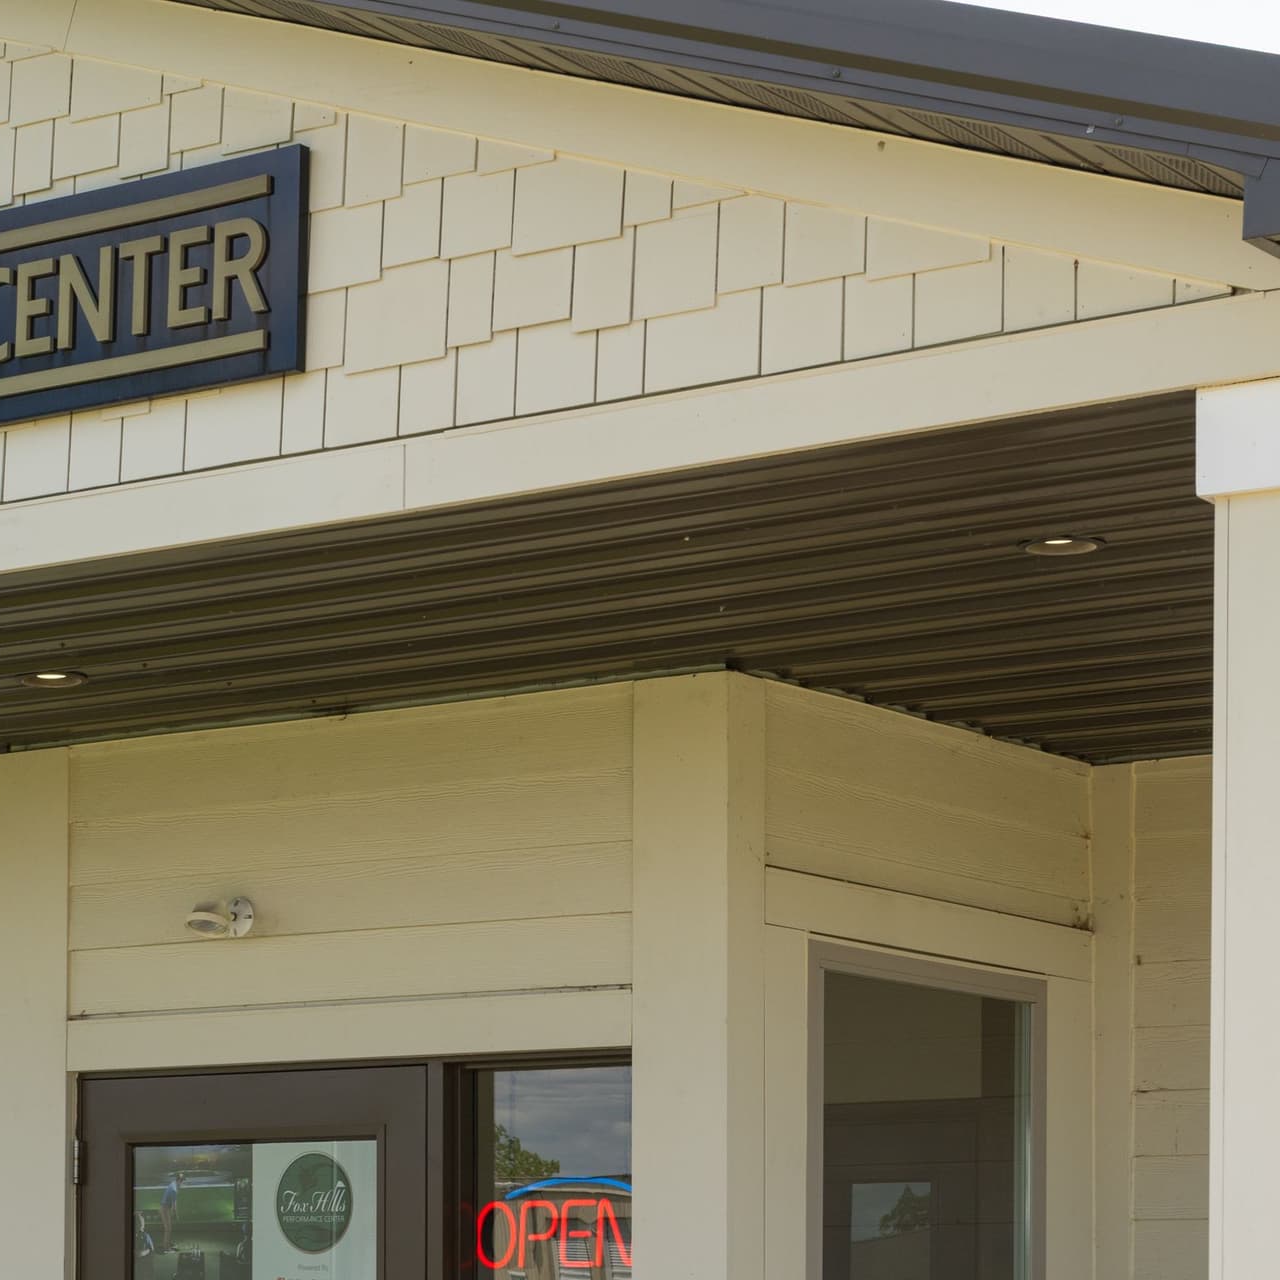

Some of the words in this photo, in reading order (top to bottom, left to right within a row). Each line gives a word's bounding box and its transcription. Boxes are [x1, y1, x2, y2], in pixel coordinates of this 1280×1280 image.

[280, 1190, 308, 1213] Fox
[283, 1215, 323, 1223] PERFORMANCE
[324, 1215, 345, 1223] CENTER
[476, 1198, 632, 1269] OPEN
